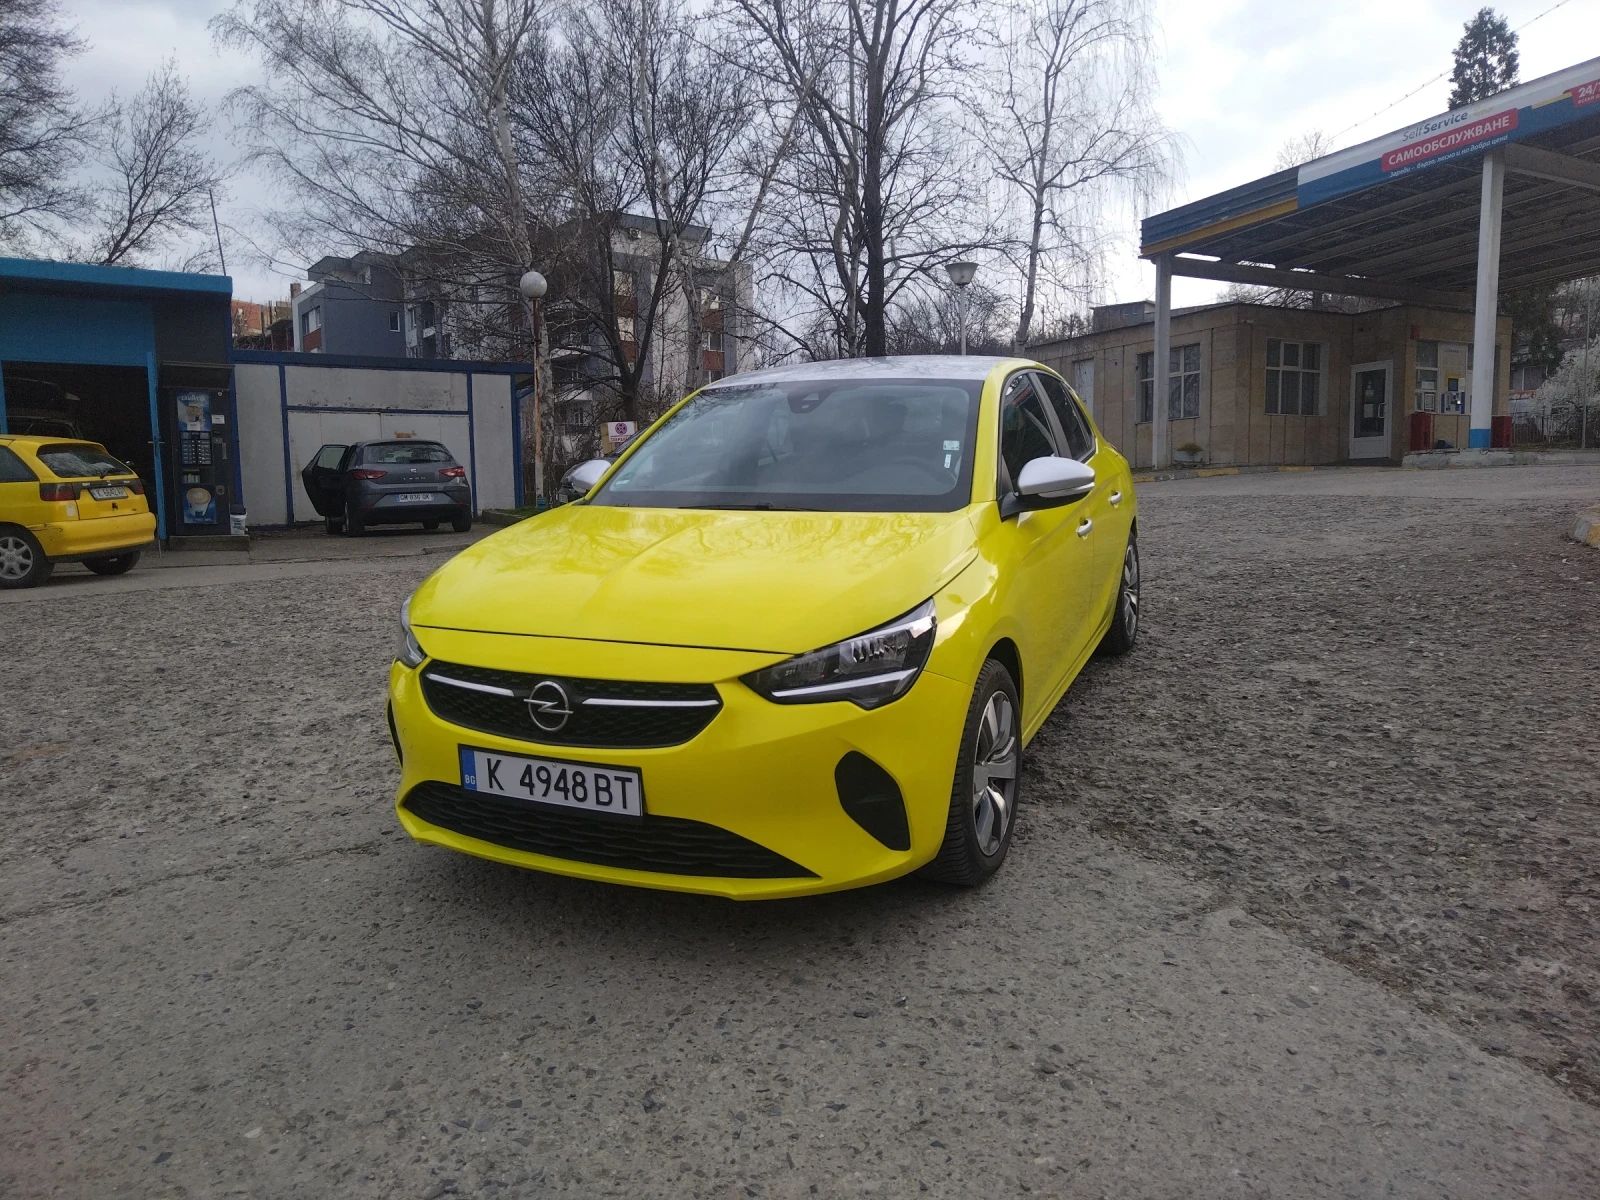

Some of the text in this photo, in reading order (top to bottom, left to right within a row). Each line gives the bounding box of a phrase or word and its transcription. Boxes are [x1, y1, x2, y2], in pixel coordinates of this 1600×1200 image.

[1578, 82, 1600, 98] 24/
[1388, 116, 1510, 165] САМООБСЛУЖВАНЕ
[1470, 141, 1491, 152] добра
[1491, 135, 1508, 145] цена
[465, 774, 476, 785] BG
[487, 758, 633, 809] K 4948 BT
